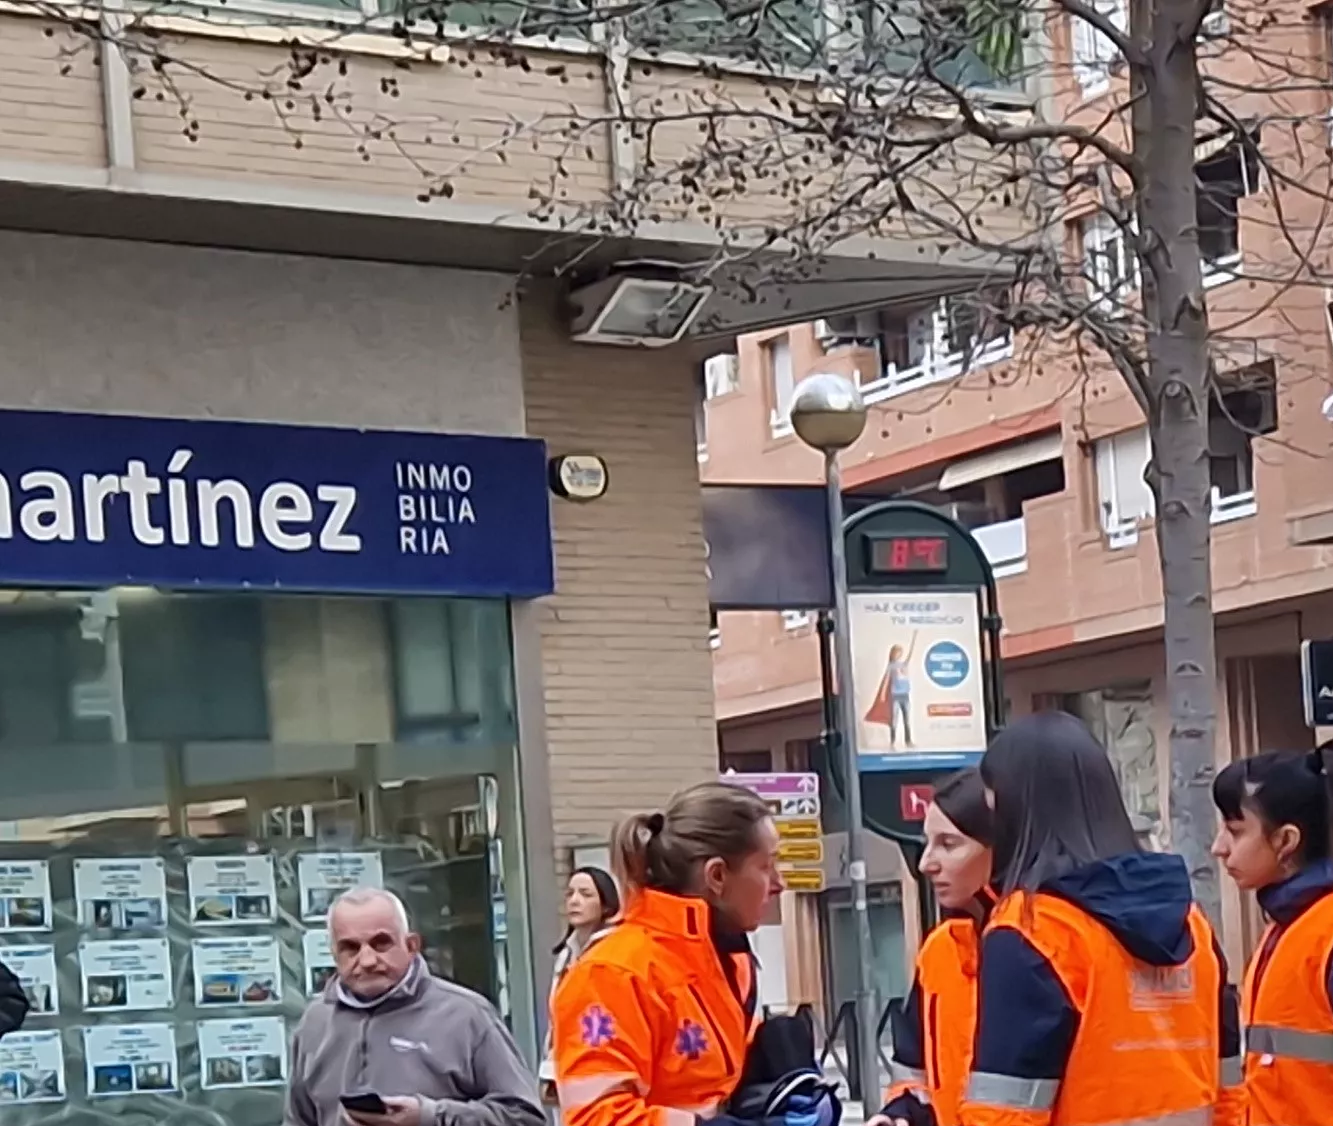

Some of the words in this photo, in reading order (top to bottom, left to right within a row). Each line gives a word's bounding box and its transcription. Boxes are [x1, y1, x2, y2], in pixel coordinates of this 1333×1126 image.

[396, 461, 472, 493] INMO
[0, 450, 362, 552] artínez
[398, 493, 476, 524] BILIA
[401, 526, 450, 555] RIA
